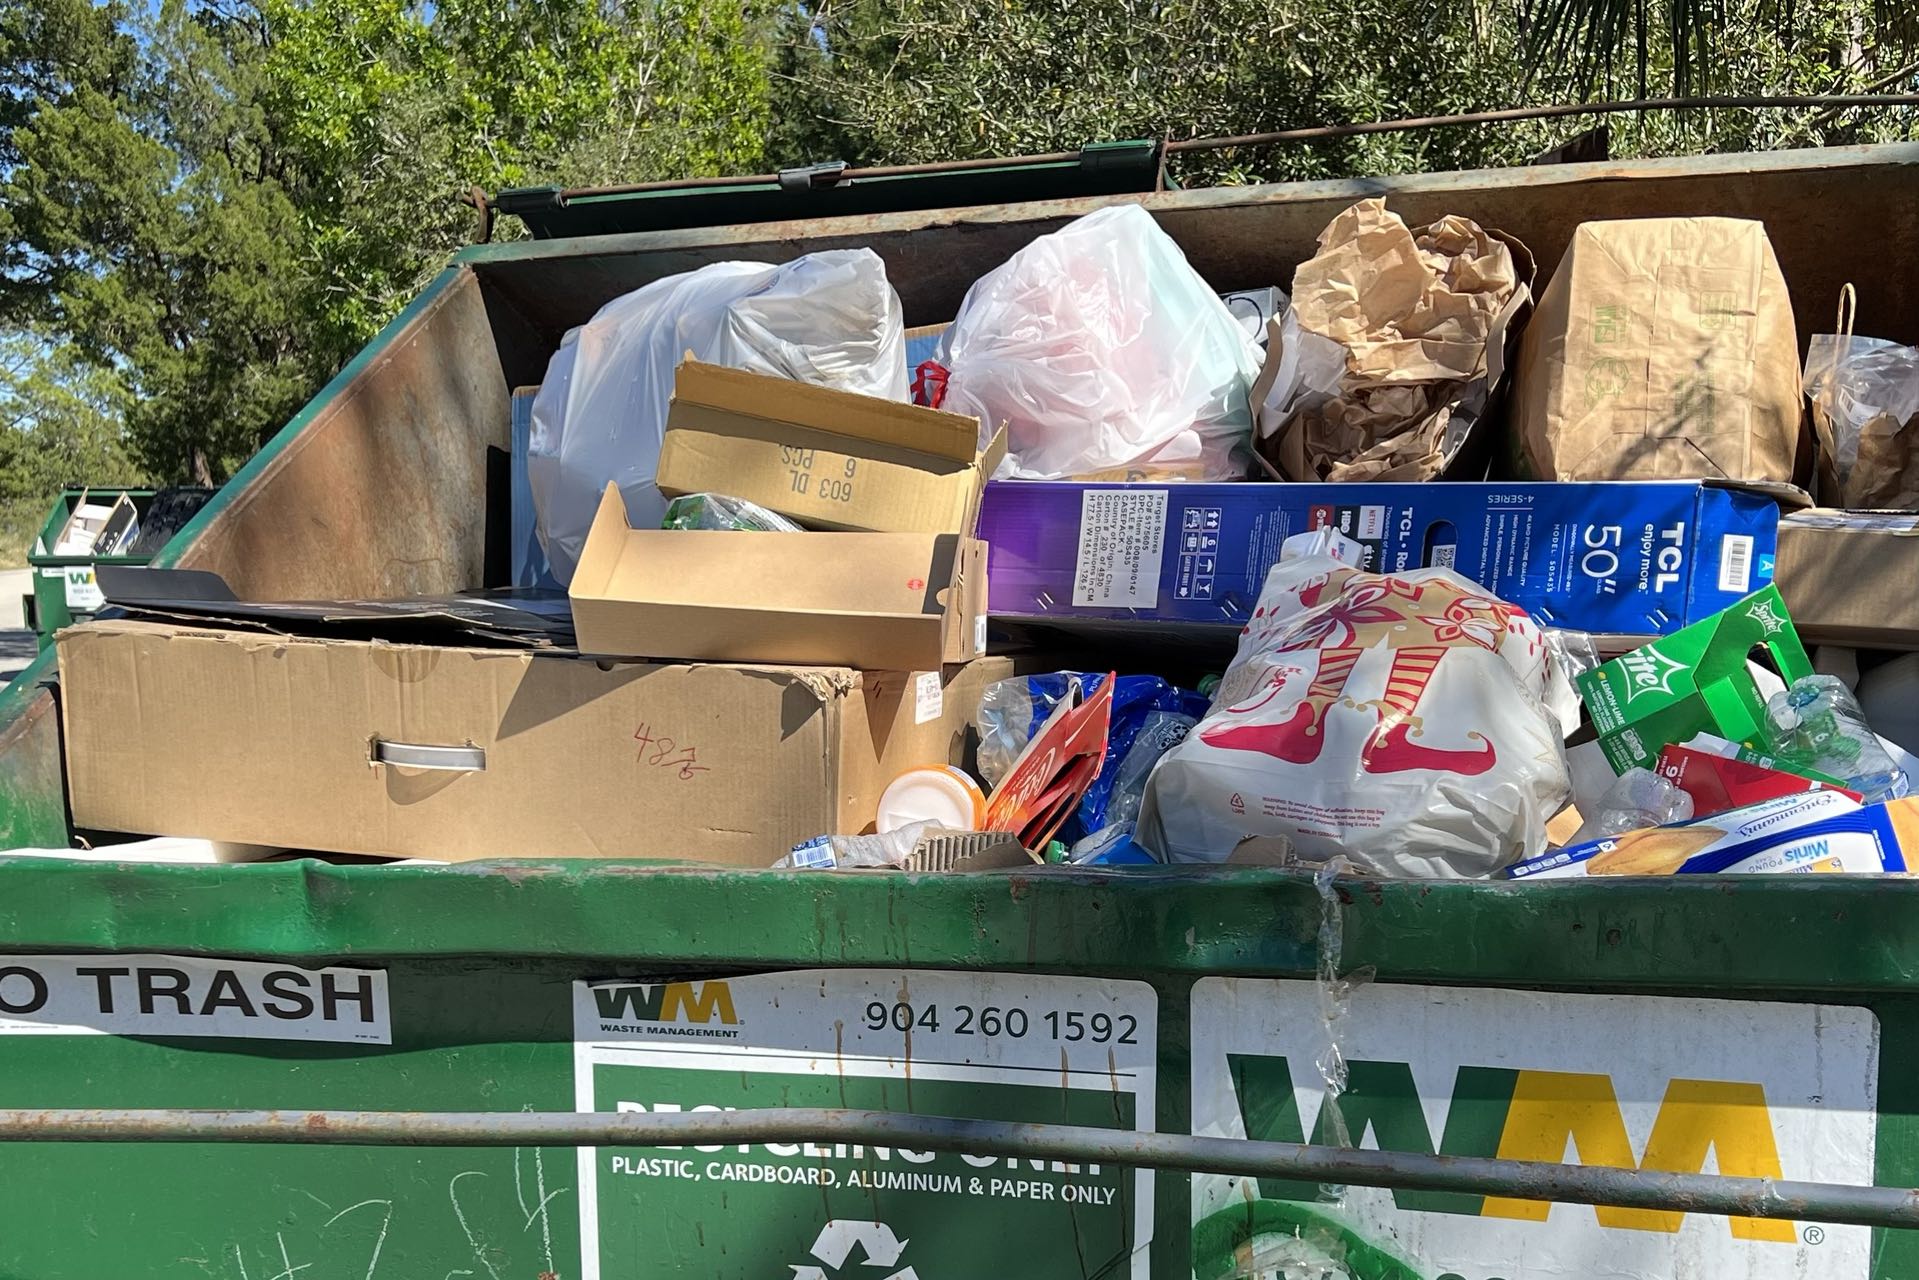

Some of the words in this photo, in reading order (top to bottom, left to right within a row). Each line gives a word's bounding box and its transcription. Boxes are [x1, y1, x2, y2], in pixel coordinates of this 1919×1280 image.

[1111, 495, 1120, 529] Country
[1154, 496, 1164, 523] Target
[1488, 494, 1534, 504] 4-SERIES
[1111, 532, 1116, 540] of
[1339, 510, 1351, 533] HBO
[1366, 509, 1376, 535] NETFLIX
[1400, 507, 1414, 541] TCL
[1090, 526, 1101, 575] Dimensions
[1152, 526, 1160, 554] Stores
[1641, 524, 1654, 556] enjoy
[1100, 557, 1105, 565] of
[1656, 522, 1684, 592] TCL
[1087, 588, 1094, 601] CM
[1104, 574, 1112, 598] China
[1753, 603, 1778, 632] Sprite
[1623, 648, 1659, 687] rite
[1599, 678, 1626, 725] LEMON-LIME
[1666, 766, 1678, 778] 6
[1784, 841, 1830, 864] Minis
[76, 967, 374, 1022] TRASH
[593, 981, 738, 1024] WM
[600, 1024, 644, 1034] WASTE
[646, 1026, 738, 1038] MANAGEMENT
[866, 1002, 940, 1032] 904
[954, 1005, 1028, 1037] 260
[1044, 1010, 1138, 1044] 1592
[1226, 1052, 1797, 1244] WM
[612, 1156, 700, 1182] PLASTIC,
[706, 1162, 842, 1189] CARDBOARD,
[846, 1170, 962, 1194] ALUMINUM
[968, 1178, 984, 1196] &
[991, 1178, 1054, 1201] PAPER
[1061, 1184, 1116, 1206] ONLY
